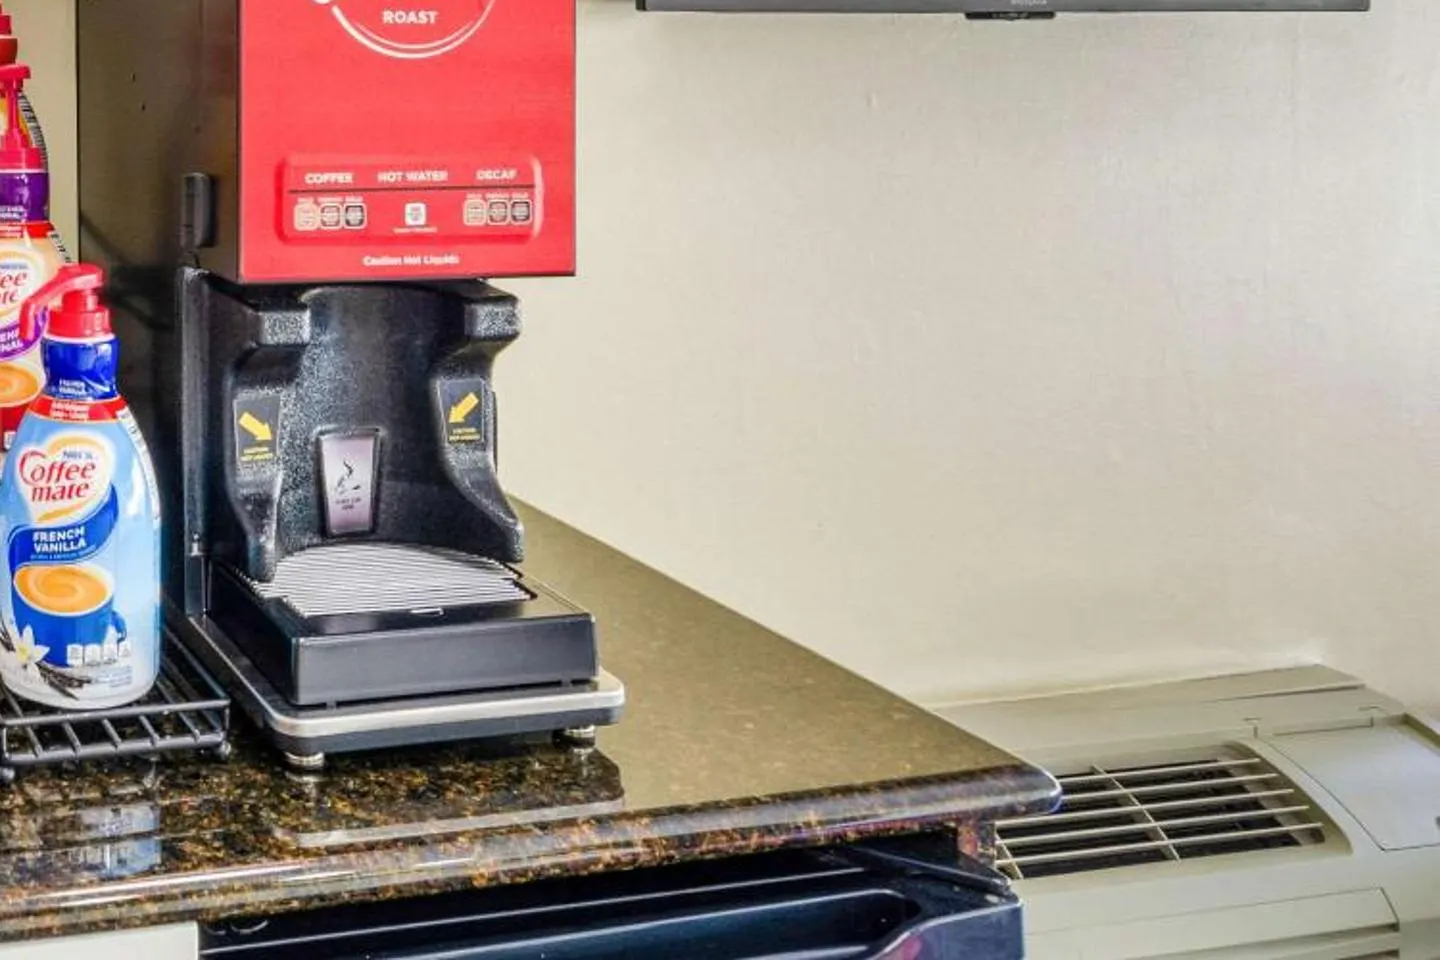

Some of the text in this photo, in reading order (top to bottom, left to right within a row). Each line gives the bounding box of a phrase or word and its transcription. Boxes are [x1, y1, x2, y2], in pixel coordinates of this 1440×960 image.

[382, 10, 438, 25] ROAST
[304, 171, 354, 185] COFFEE
[378, 169, 449, 183] HOT WATER
[476, 167, 517, 181] DECAF
[19, 450, 97, 485] Coffee
[31, 483, 89, 502] mate
[33, 526, 86, 542] FRENCH
[33, 538, 87, 553] VANILLA
